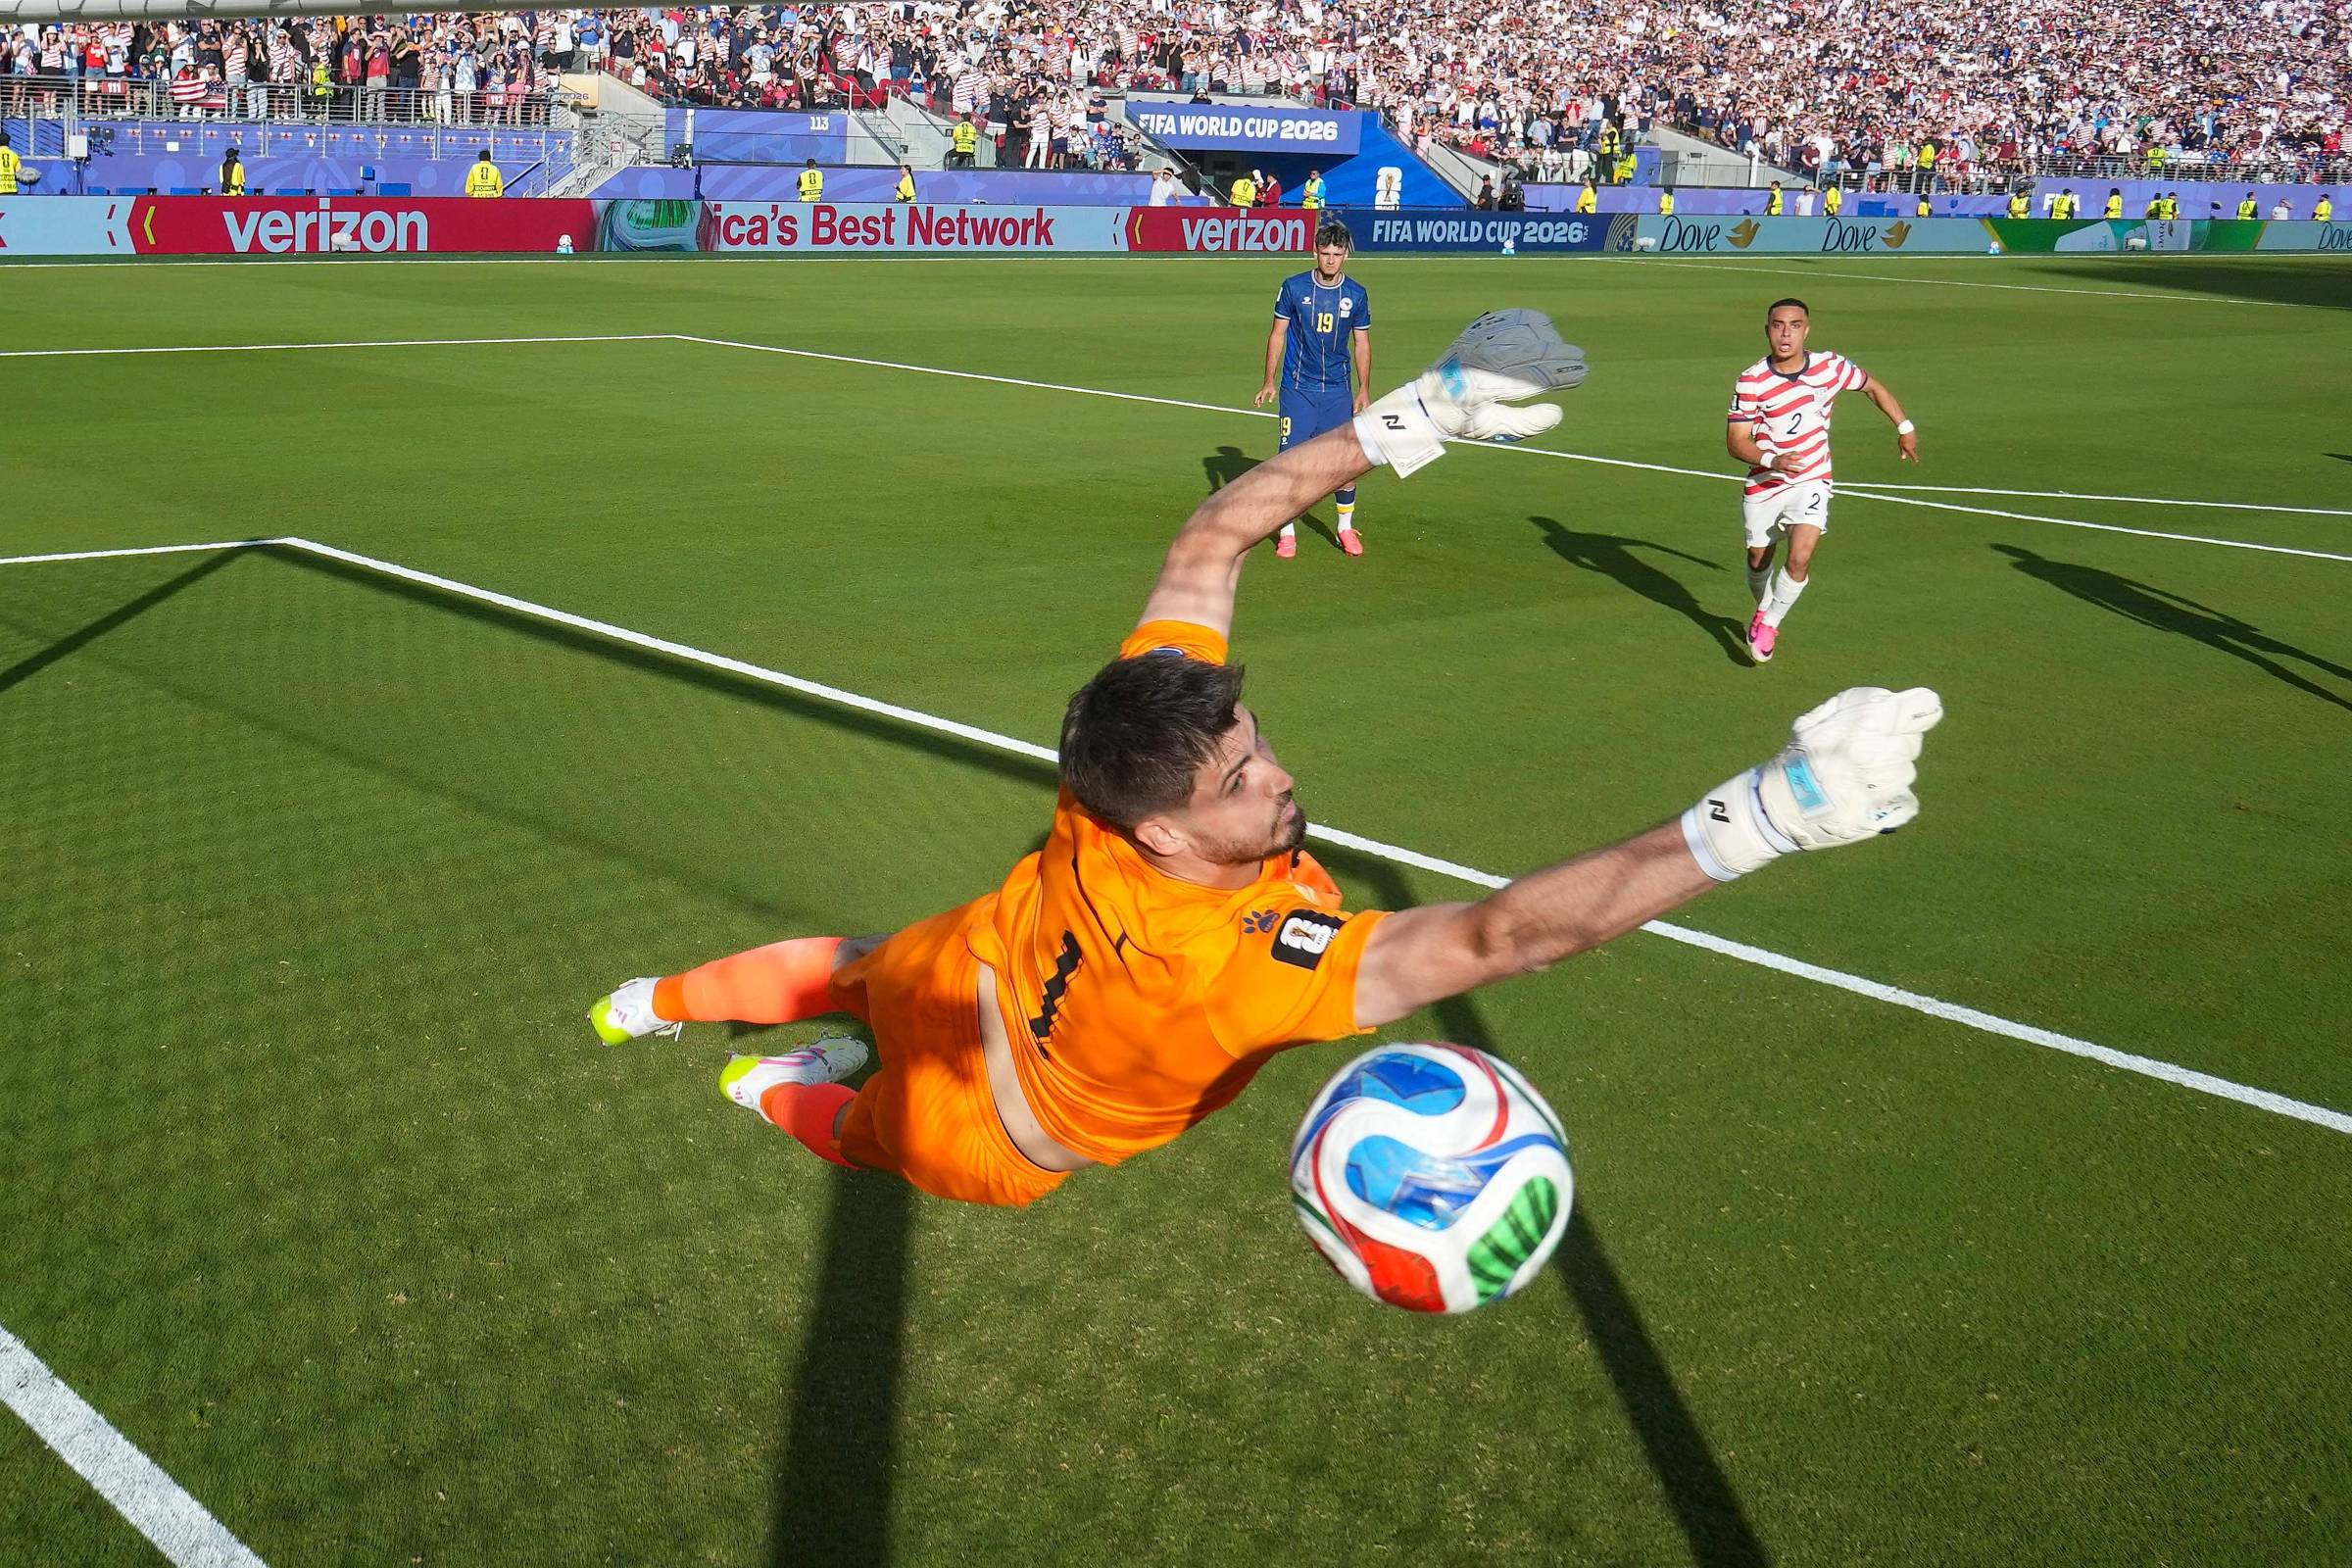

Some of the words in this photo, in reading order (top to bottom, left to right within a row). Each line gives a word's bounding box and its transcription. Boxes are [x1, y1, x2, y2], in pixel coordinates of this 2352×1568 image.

[108, 82, 122, 93] 111
[490, 95, 504, 104] 112
[809, 116, 829, 131] 113
[1138, 114, 1177, 135] FIFA
[1179, 115, 1243, 137] WORLD
[1244, 118, 1279, 139] CUP
[1280, 120, 1339, 141] 2026
[222, 197, 428, 253] verizon
[811, 205, 896, 245] Best
[906, 206, 1054, 246] Network
[1182, 209, 1305, 252] verizon
[1372, 220, 1412, 242] FIFA
[1416, 221, 1484, 242] WORLD
[1486, 222, 1520, 243] CUP
[1522, 222, 1583, 243] 2026
[1659, 215, 1721, 252] Dove
[1821, 217, 1877, 252] Dove
[2318, 221, 2352, 250] Dove
[1316, 312, 1334, 333] 19
[1787, 413, 1802, 434] 2
[1808, 492, 1821, 510] 2
